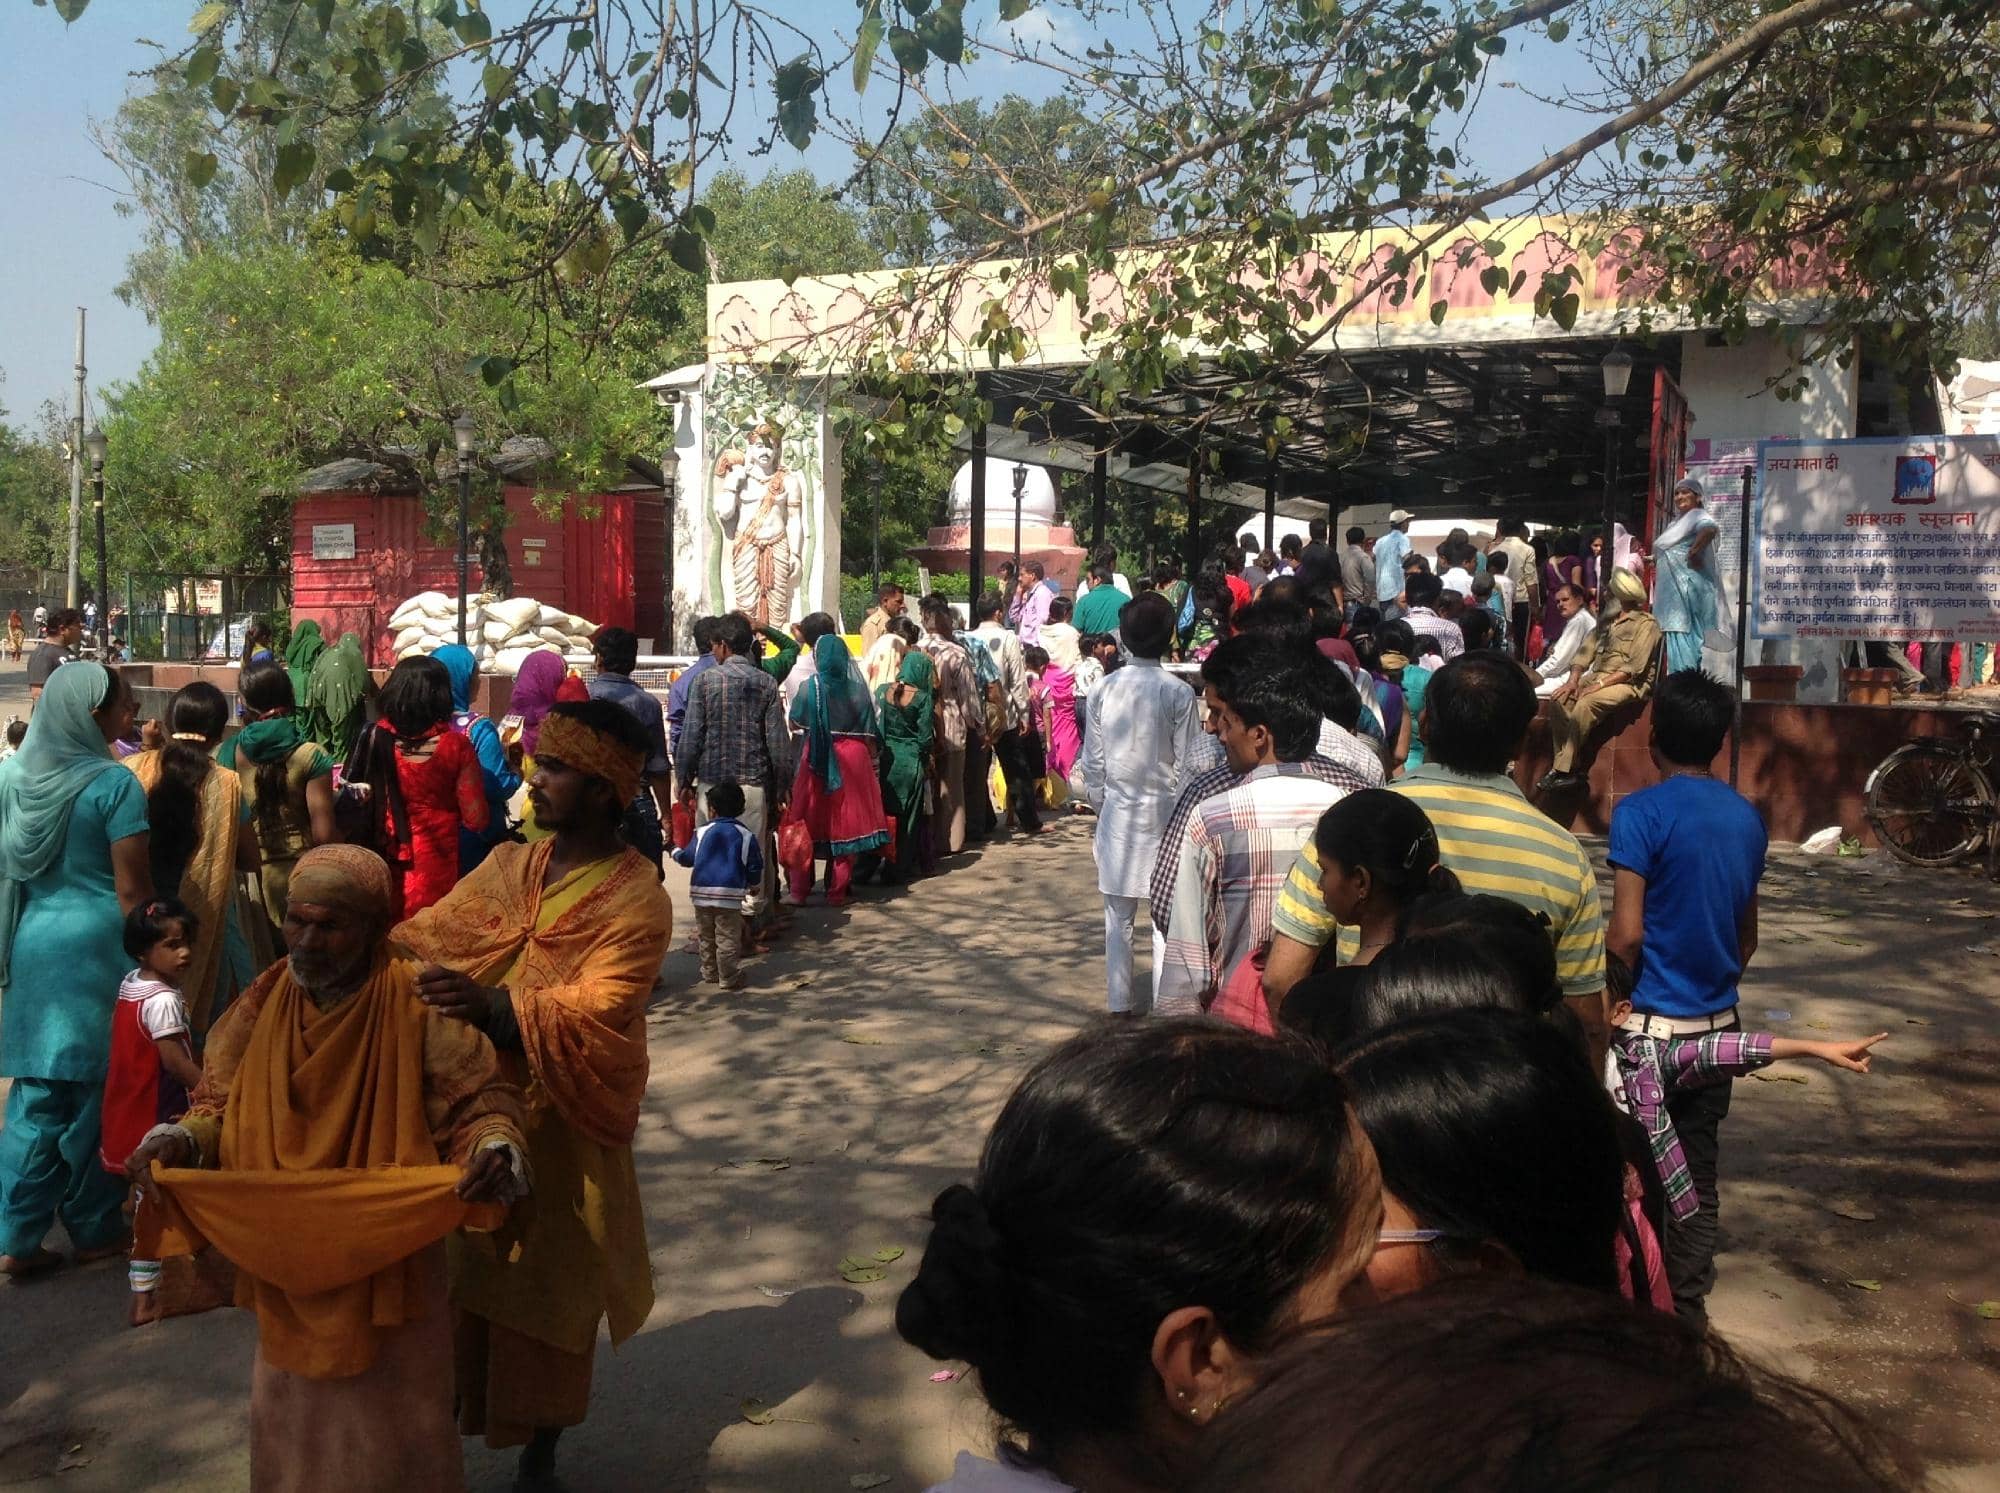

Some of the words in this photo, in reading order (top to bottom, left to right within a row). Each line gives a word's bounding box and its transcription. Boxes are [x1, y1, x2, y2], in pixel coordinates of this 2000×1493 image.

[1766, 457, 1790, 472] जय
[1793, 457, 1822, 471] माता
[1824, 453, 1839, 472] दी
[1918, 511, 1977, 529] सूचना
